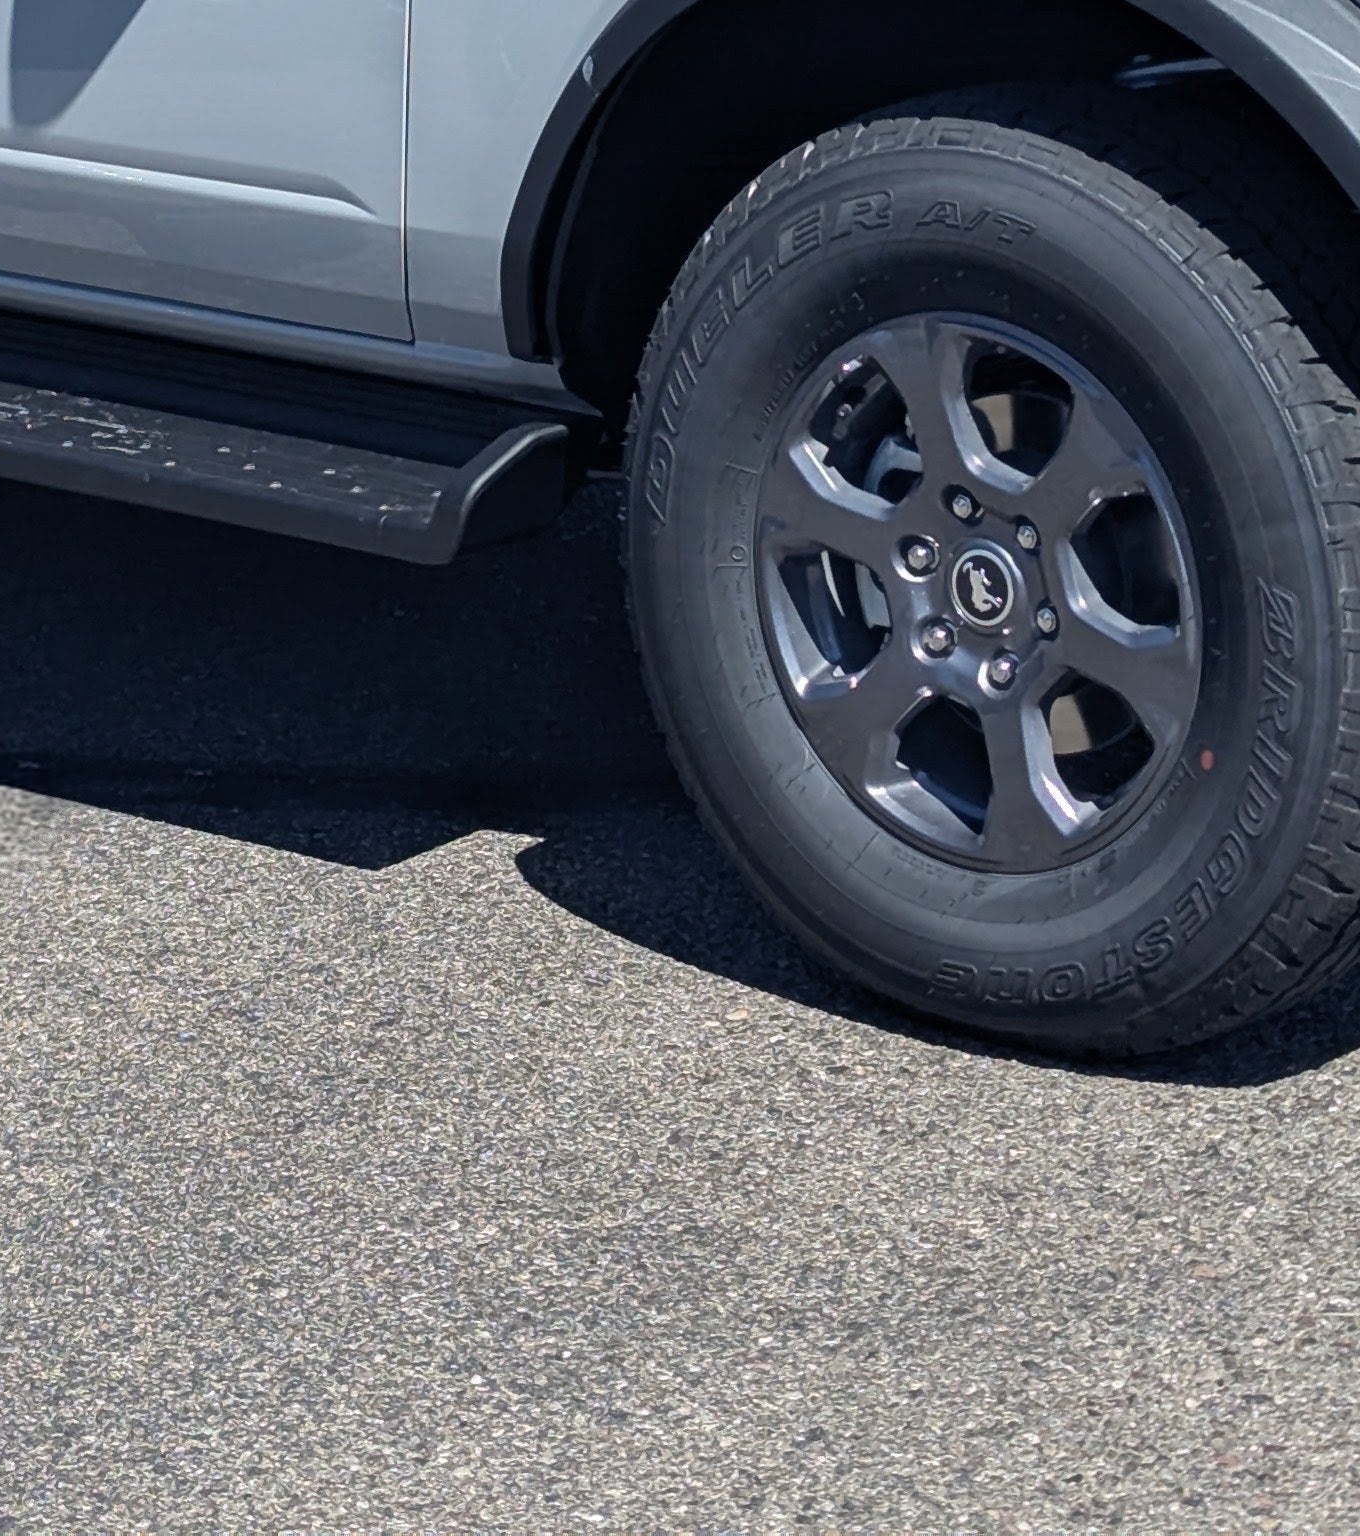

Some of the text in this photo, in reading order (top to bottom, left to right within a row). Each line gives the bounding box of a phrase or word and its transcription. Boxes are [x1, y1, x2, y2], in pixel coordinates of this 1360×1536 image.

[645, 187, 896, 525] DUELER
[914, 198, 1038, 248] A/T
[926, 576, 1302, 1007] BRIDGESTONE
